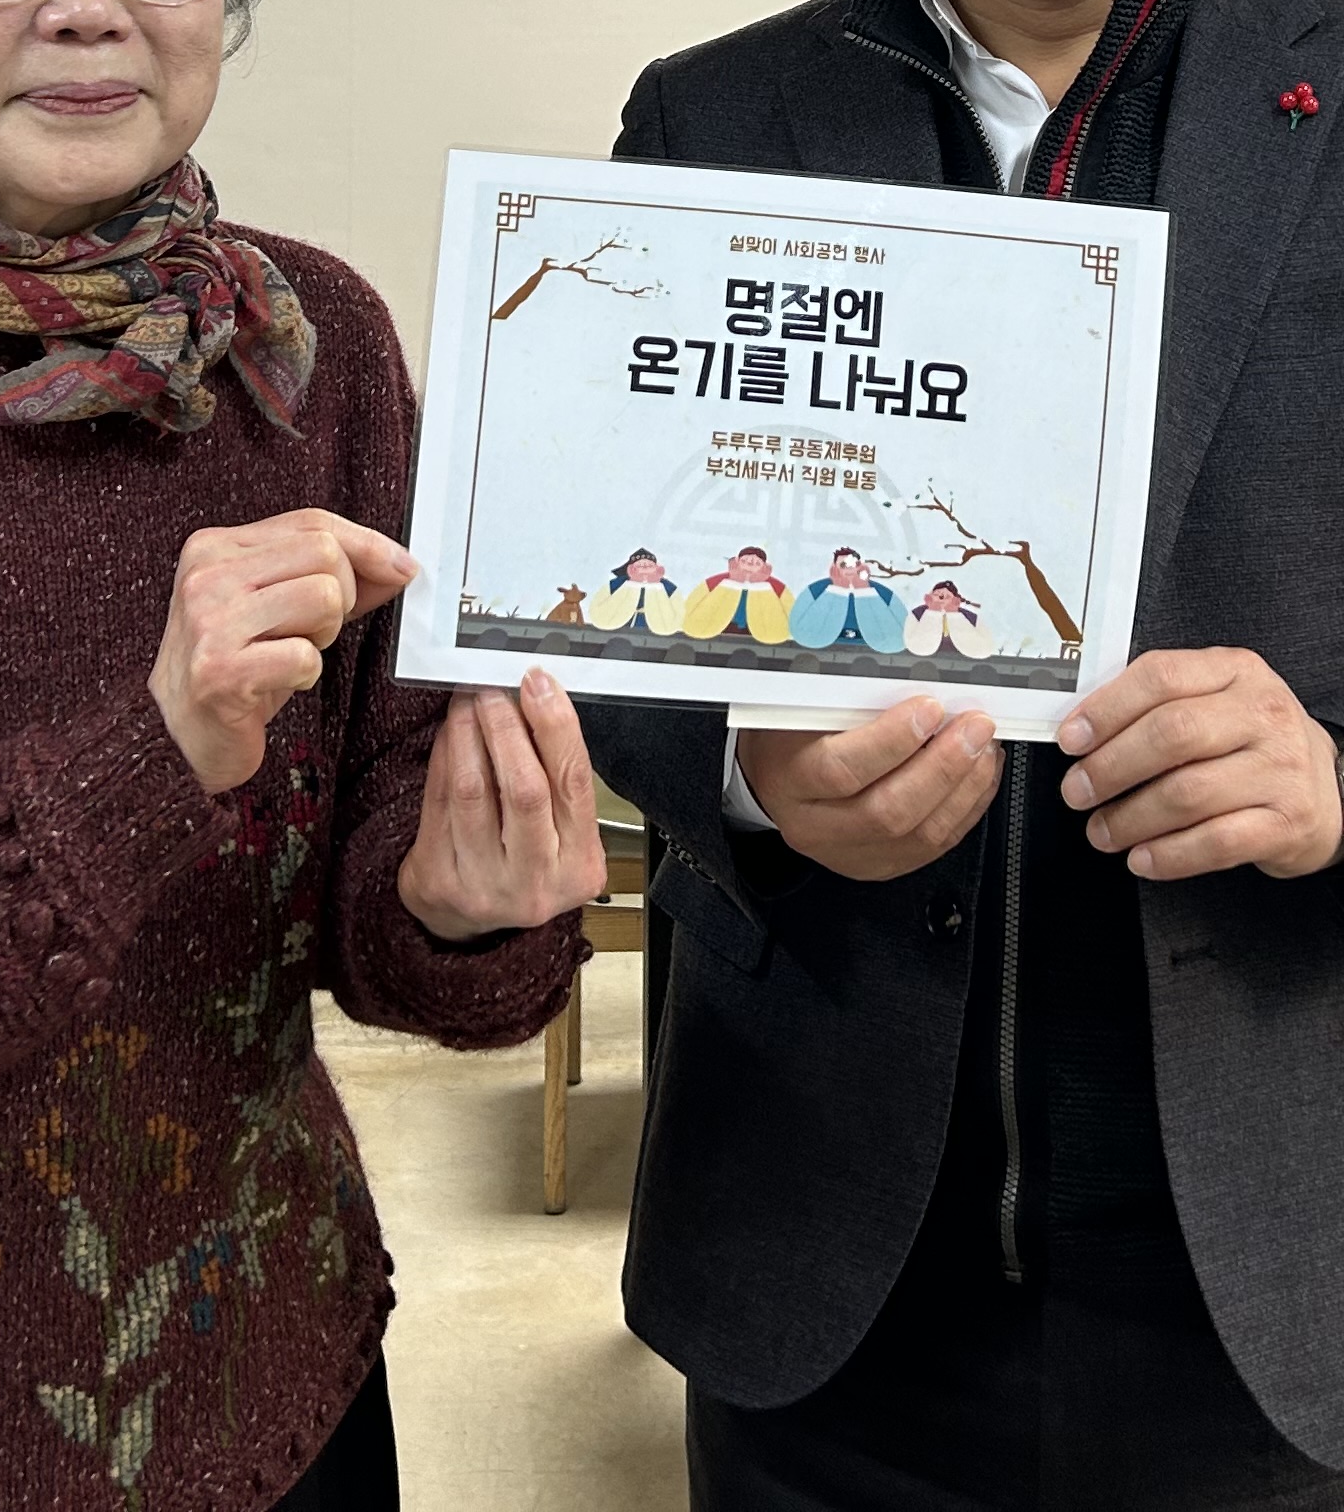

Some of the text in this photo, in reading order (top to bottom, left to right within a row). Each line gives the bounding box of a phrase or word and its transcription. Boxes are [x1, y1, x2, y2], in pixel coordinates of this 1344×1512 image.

[729, 234, 886, 265] 설맞이 사회공헌 행사
[725, 277, 884, 349] 명절엔
[627, 335, 968, 423] 온기를 나눠요
[711, 431, 782, 456] 두루두루
[706, 456, 878, 492] 부천세무서 직원 일동
